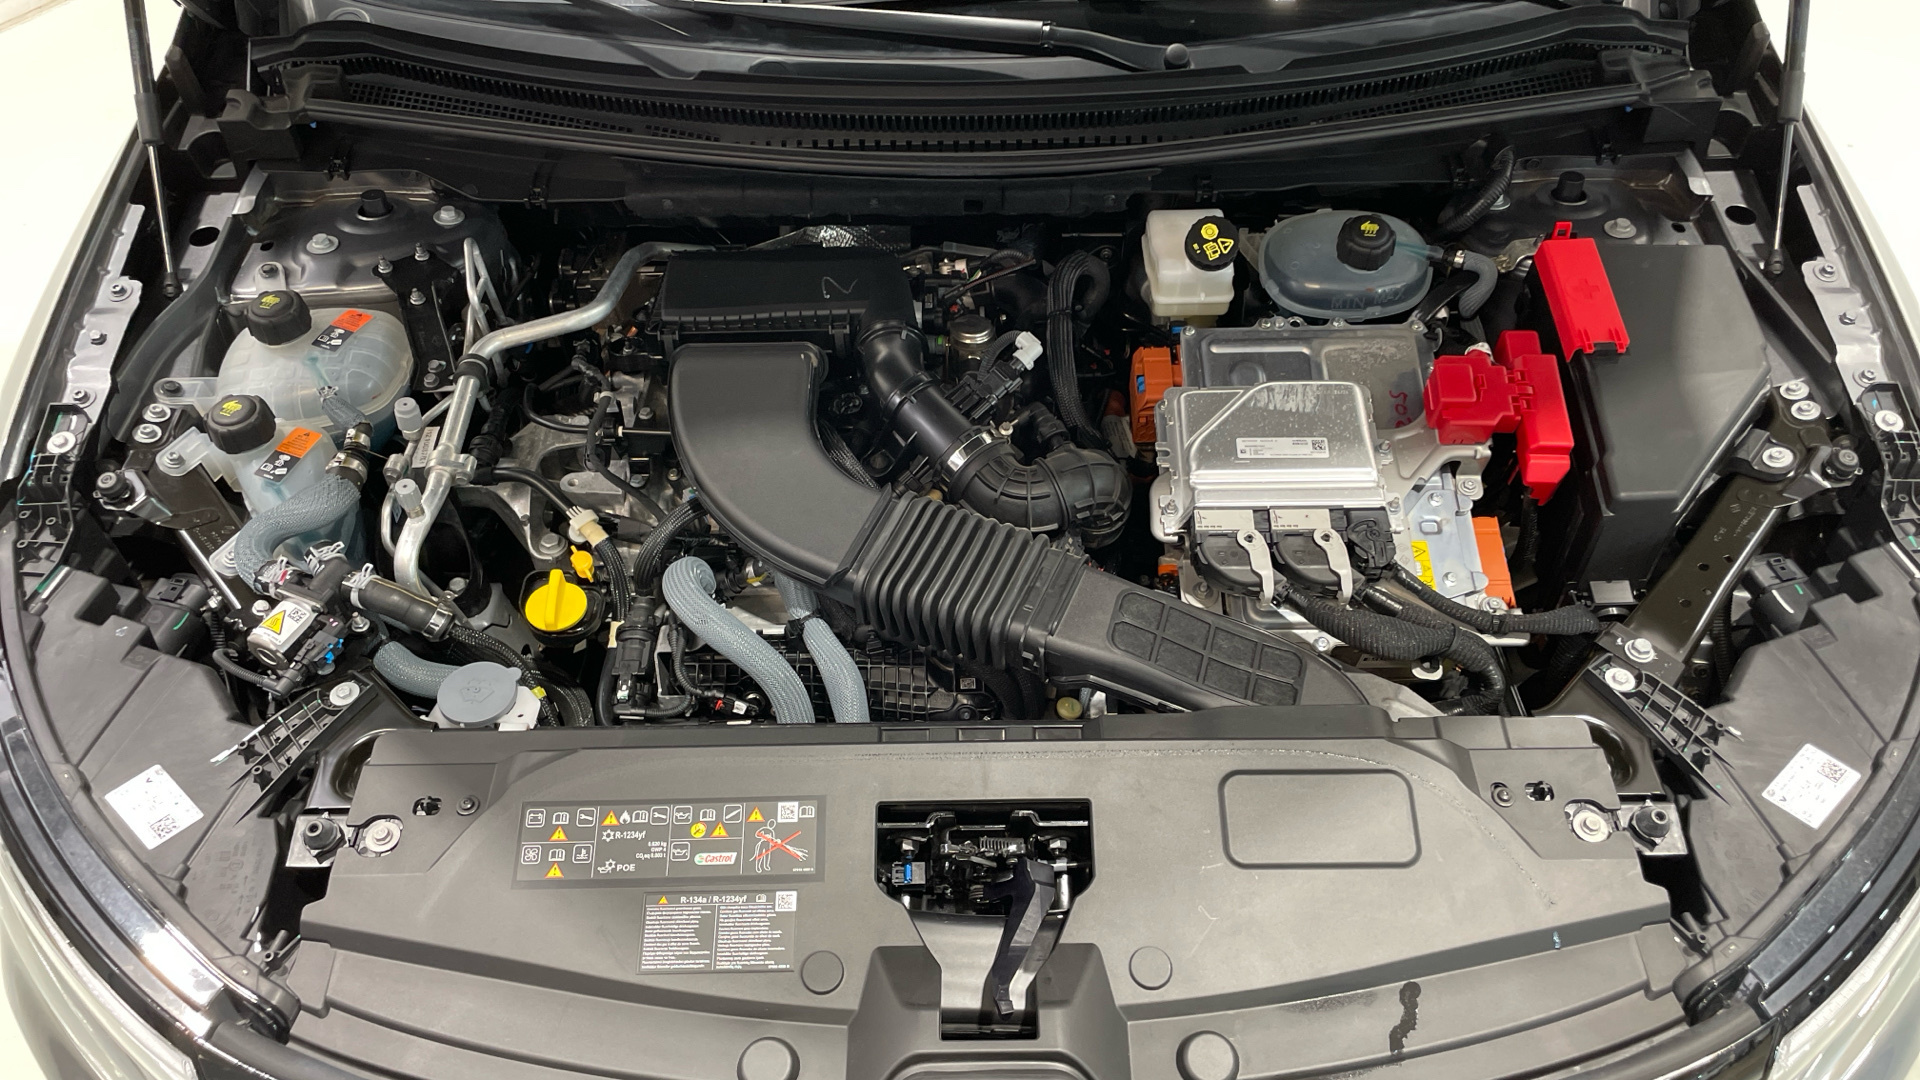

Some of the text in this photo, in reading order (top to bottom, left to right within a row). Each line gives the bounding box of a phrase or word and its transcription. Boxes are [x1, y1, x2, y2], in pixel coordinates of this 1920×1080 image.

[1331, 296, 1366, 309] MIN
[615, 830, 646, 841] R-1234yf
[704, 854, 733, 863] Castrol
[617, 863, 635, 871] POE
[680, 895, 707, 904] R-134a
[713, 895, 747, 904] R-1234yf
